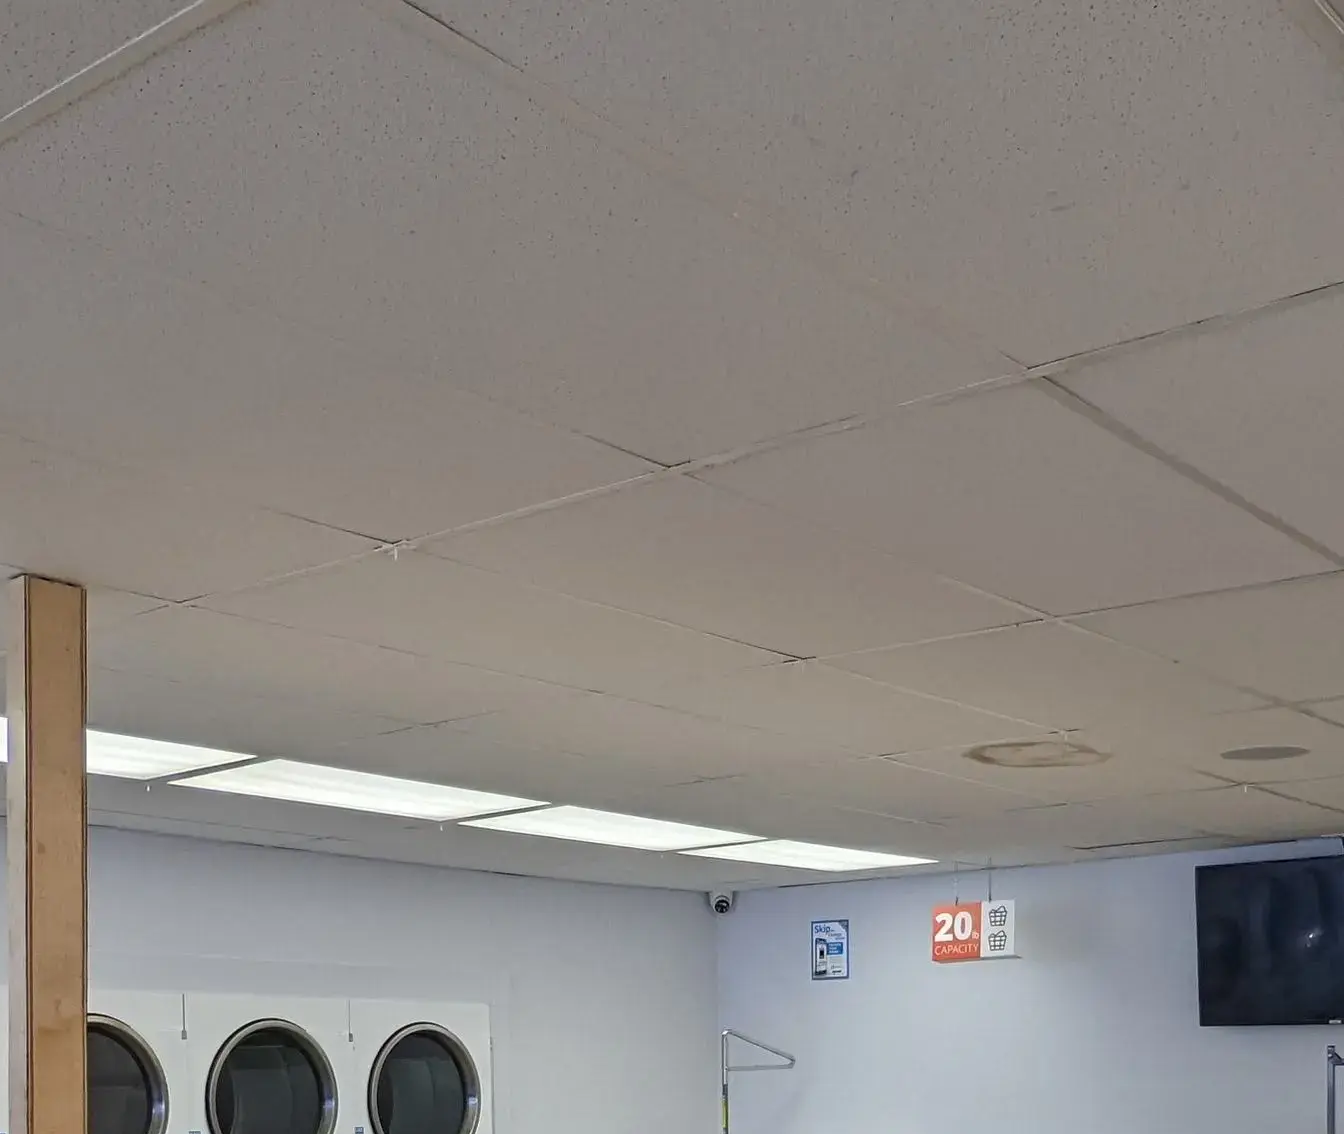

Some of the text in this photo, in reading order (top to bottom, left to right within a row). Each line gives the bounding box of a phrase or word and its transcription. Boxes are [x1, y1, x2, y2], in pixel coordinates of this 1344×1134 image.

[814, 924, 831, 935] Skip
[935, 911, 972, 942] 20
[934, 943, 979, 956] CAPACITY
